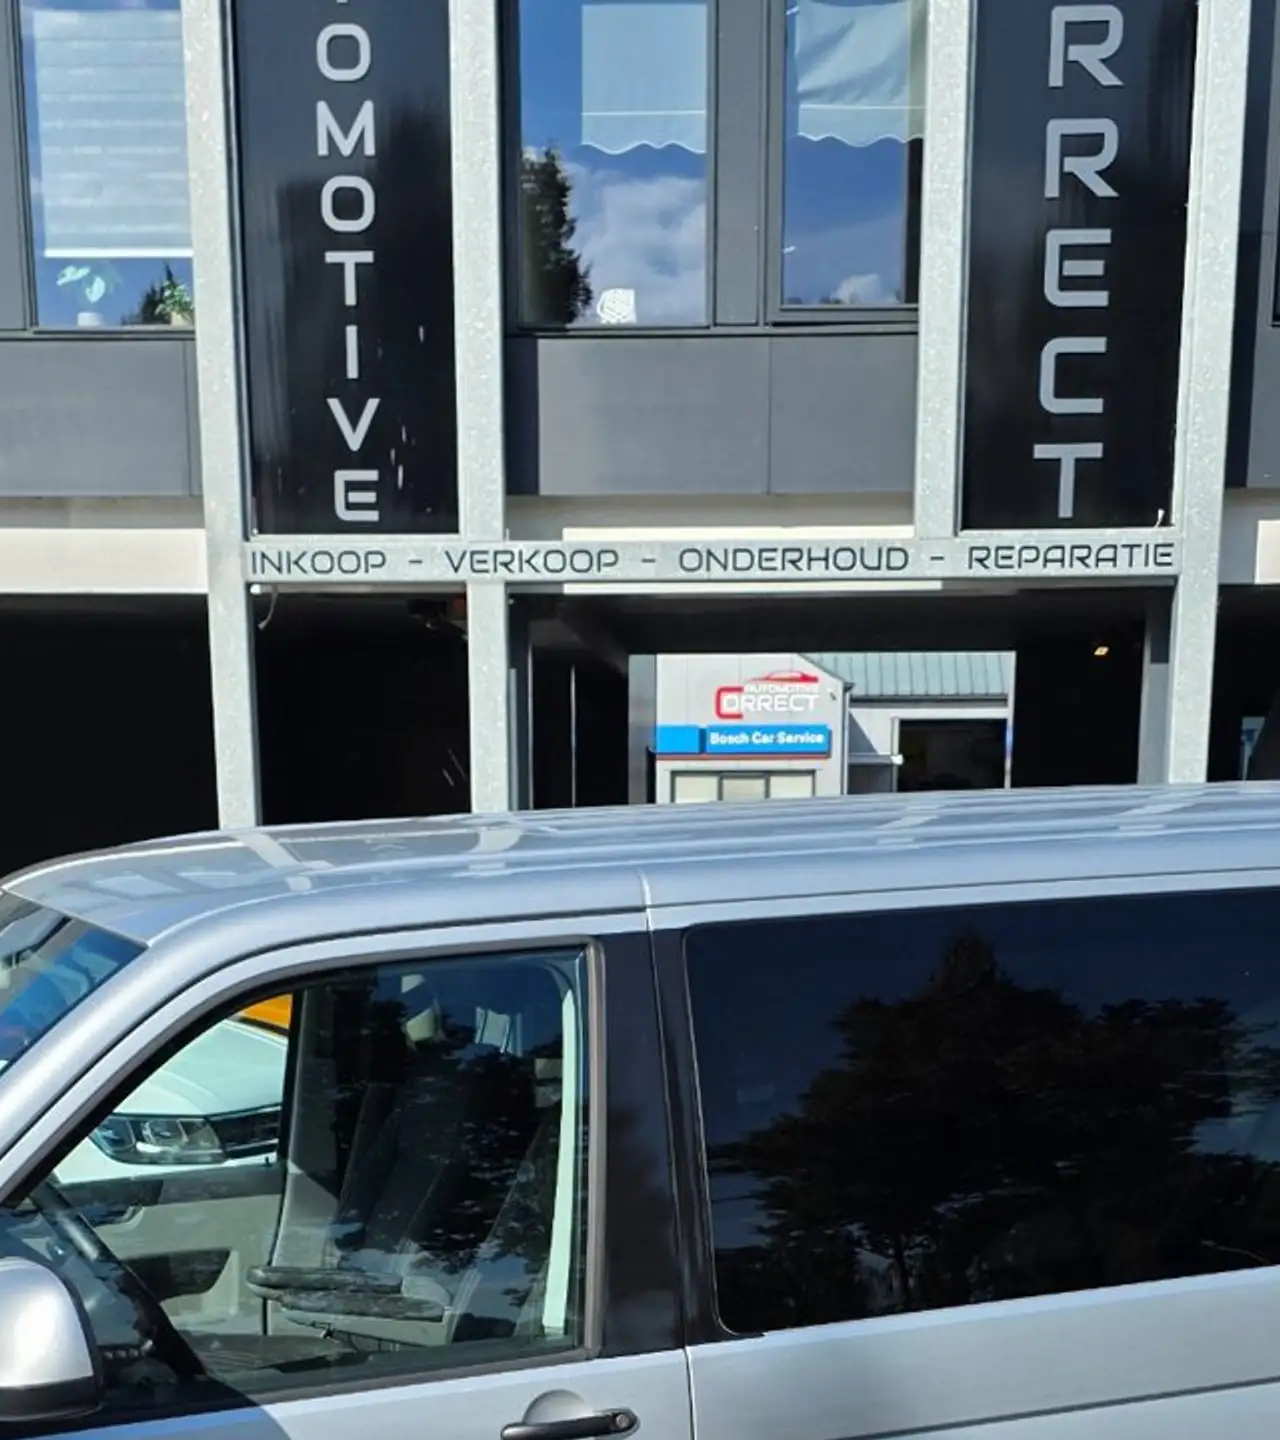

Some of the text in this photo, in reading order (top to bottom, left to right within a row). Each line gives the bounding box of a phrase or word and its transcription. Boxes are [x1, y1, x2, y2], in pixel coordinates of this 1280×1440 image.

[315, 0, 381, 522] OMOTIVE
[251, 550, 386, 575] INKOOP
[444, 548, 620, 574] VERKOOP
[678, 547, 910, 573] ONDERHOUD
[967, 543, 1176, 570] REPARATIE
[714, 685, 820, 719] CORRECT
[710, 730, 824, 745] Bosch Car Service
